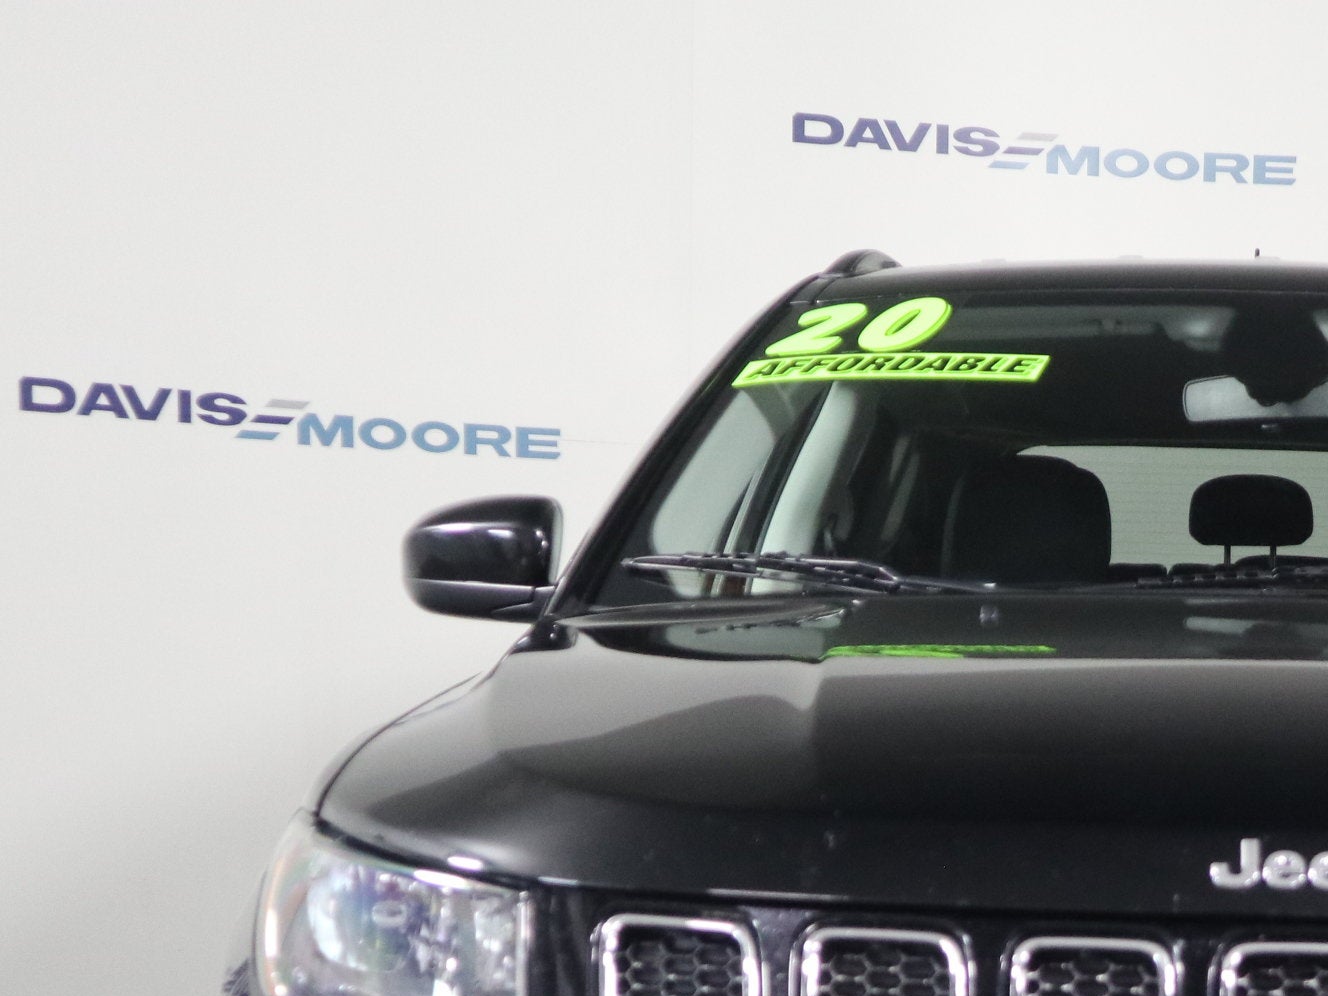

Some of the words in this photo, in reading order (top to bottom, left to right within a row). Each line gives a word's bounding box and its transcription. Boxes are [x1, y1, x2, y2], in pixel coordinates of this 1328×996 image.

[791, 111, 1001, 158] DAVIS
[1046, 144, 1297, 186] MOORE
[765, 297, 953, 356] 20
[747, 354, 1040, 378] AFFORDABLE
[17, 375, 249, 427] DAVIS
[297, 412, 561, 461] MOORE
